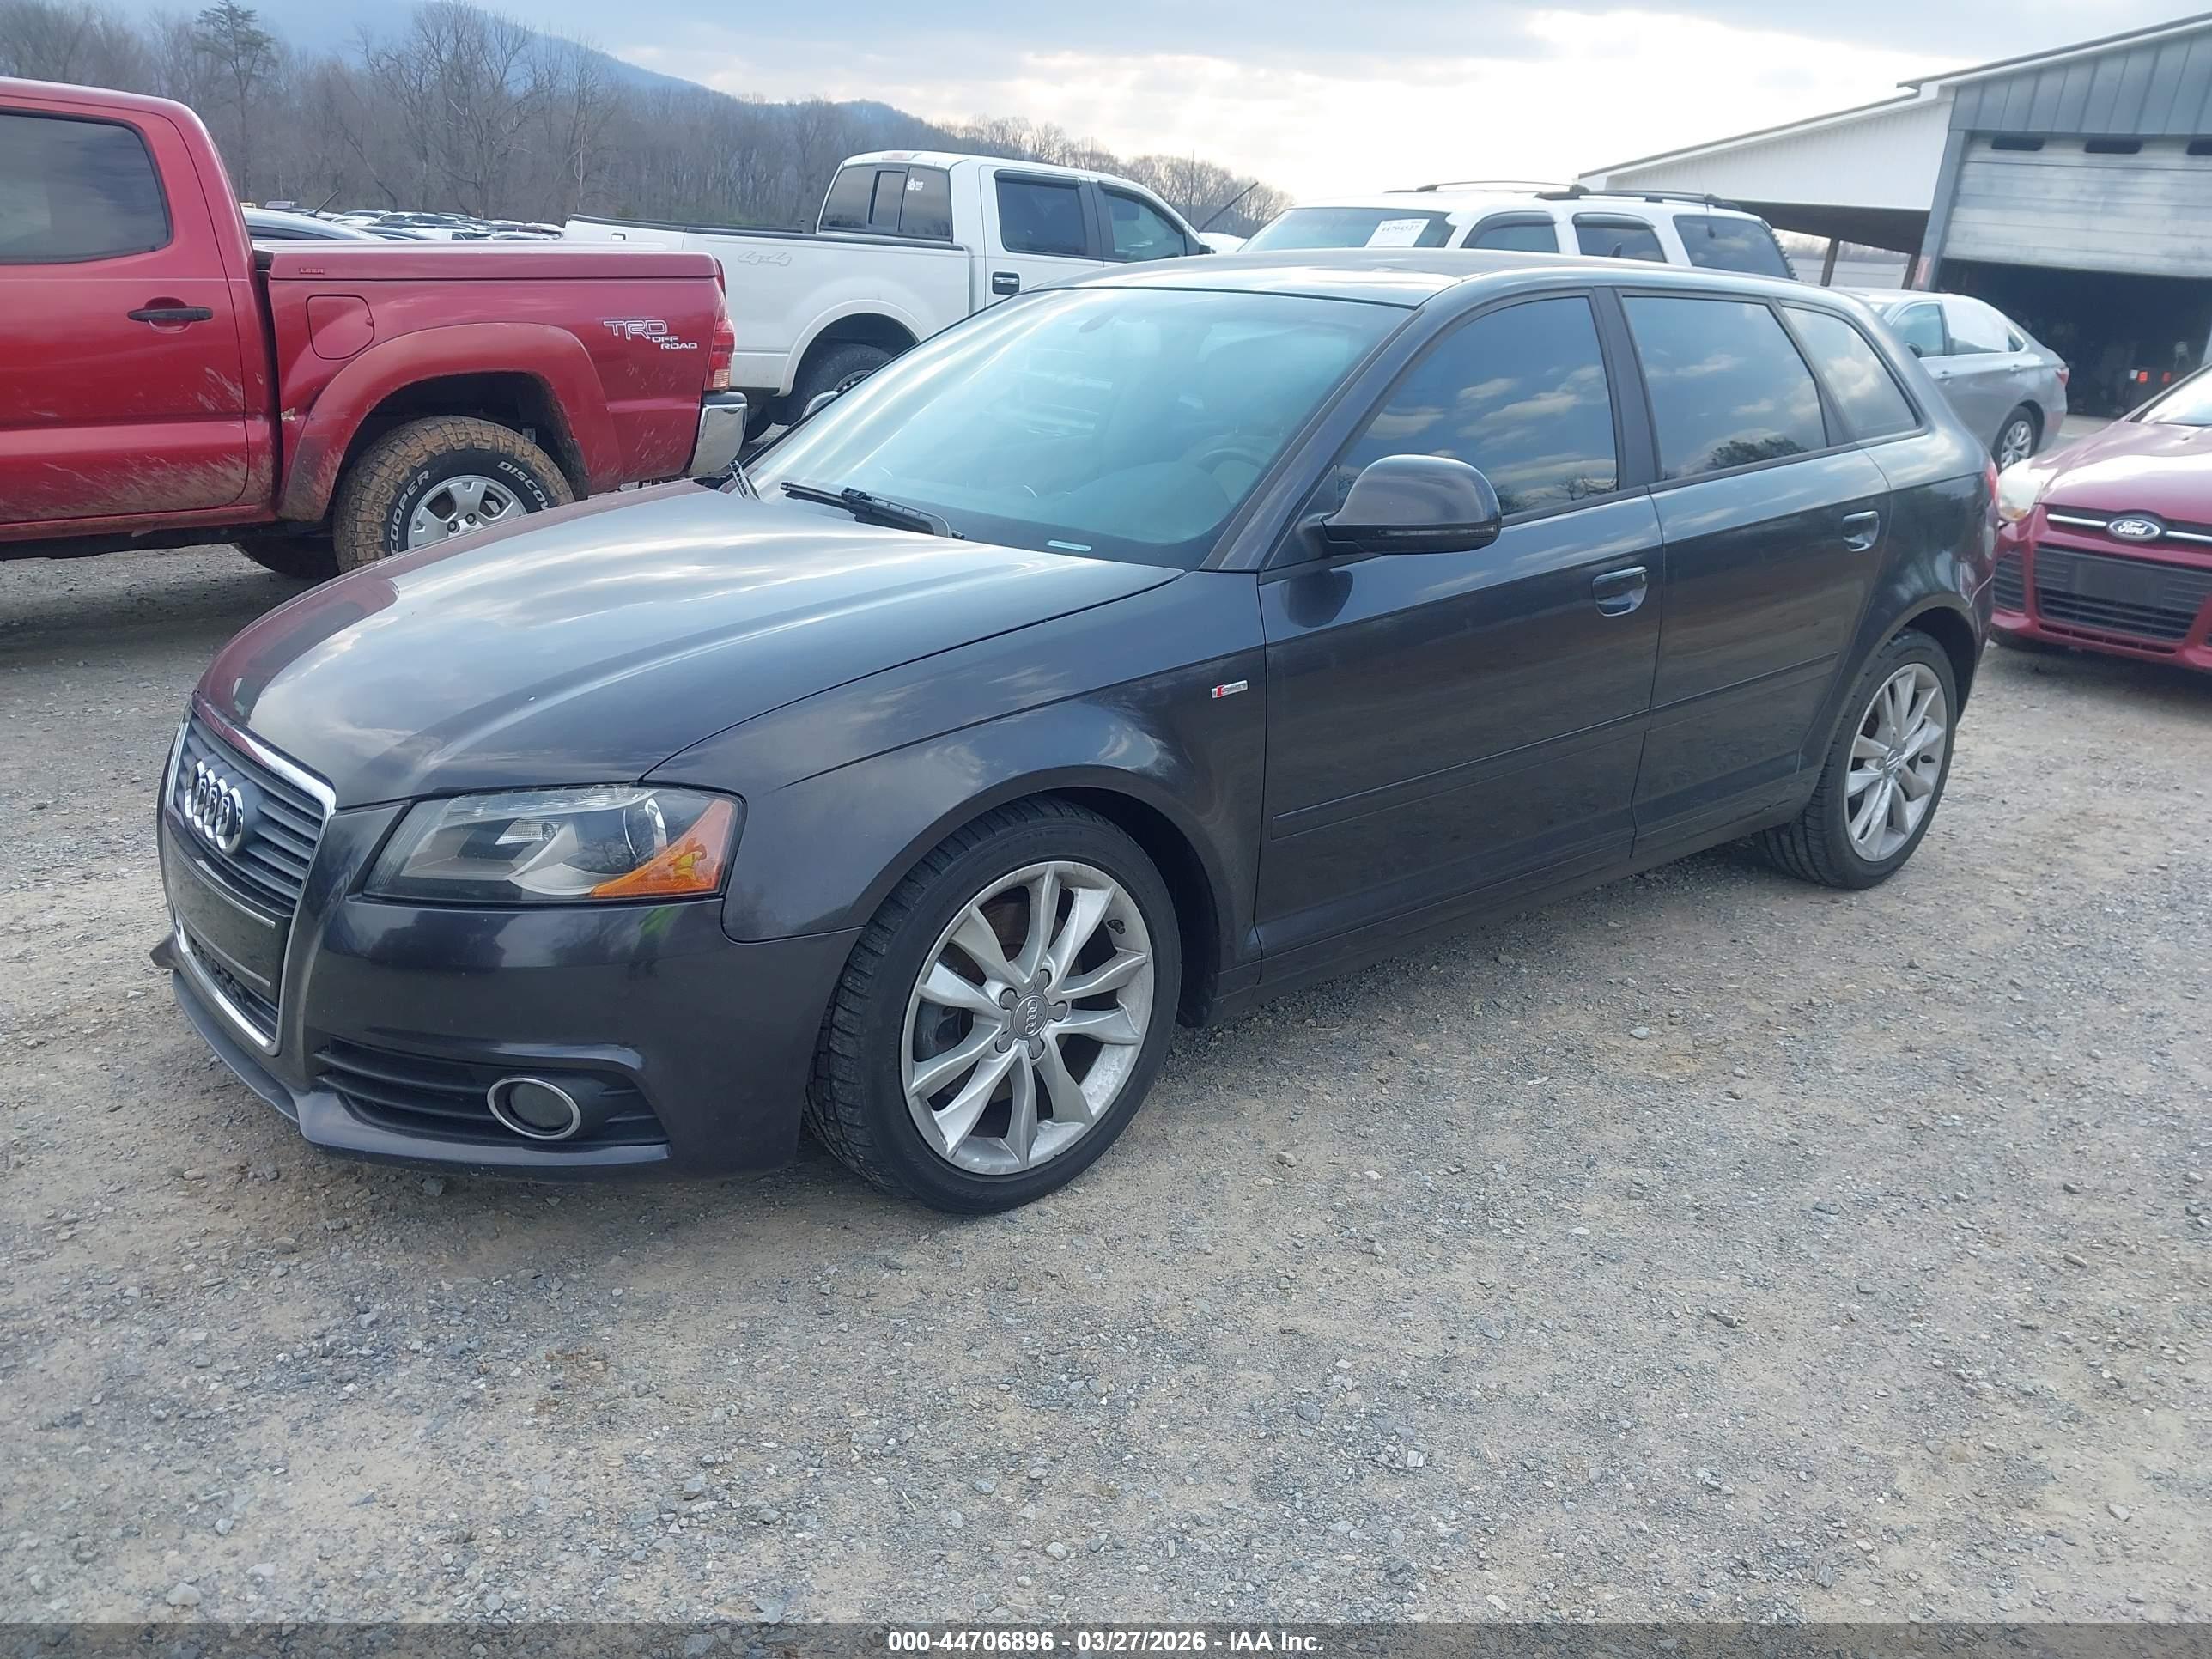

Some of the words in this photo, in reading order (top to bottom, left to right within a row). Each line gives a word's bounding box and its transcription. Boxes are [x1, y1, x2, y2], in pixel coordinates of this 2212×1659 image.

[603, 319, 668, 340] TRD
[651, 335, 679, 343] OFF
[390, 470, 429, 556] COOPER
[2118, 520, 2148, 536] Ford
